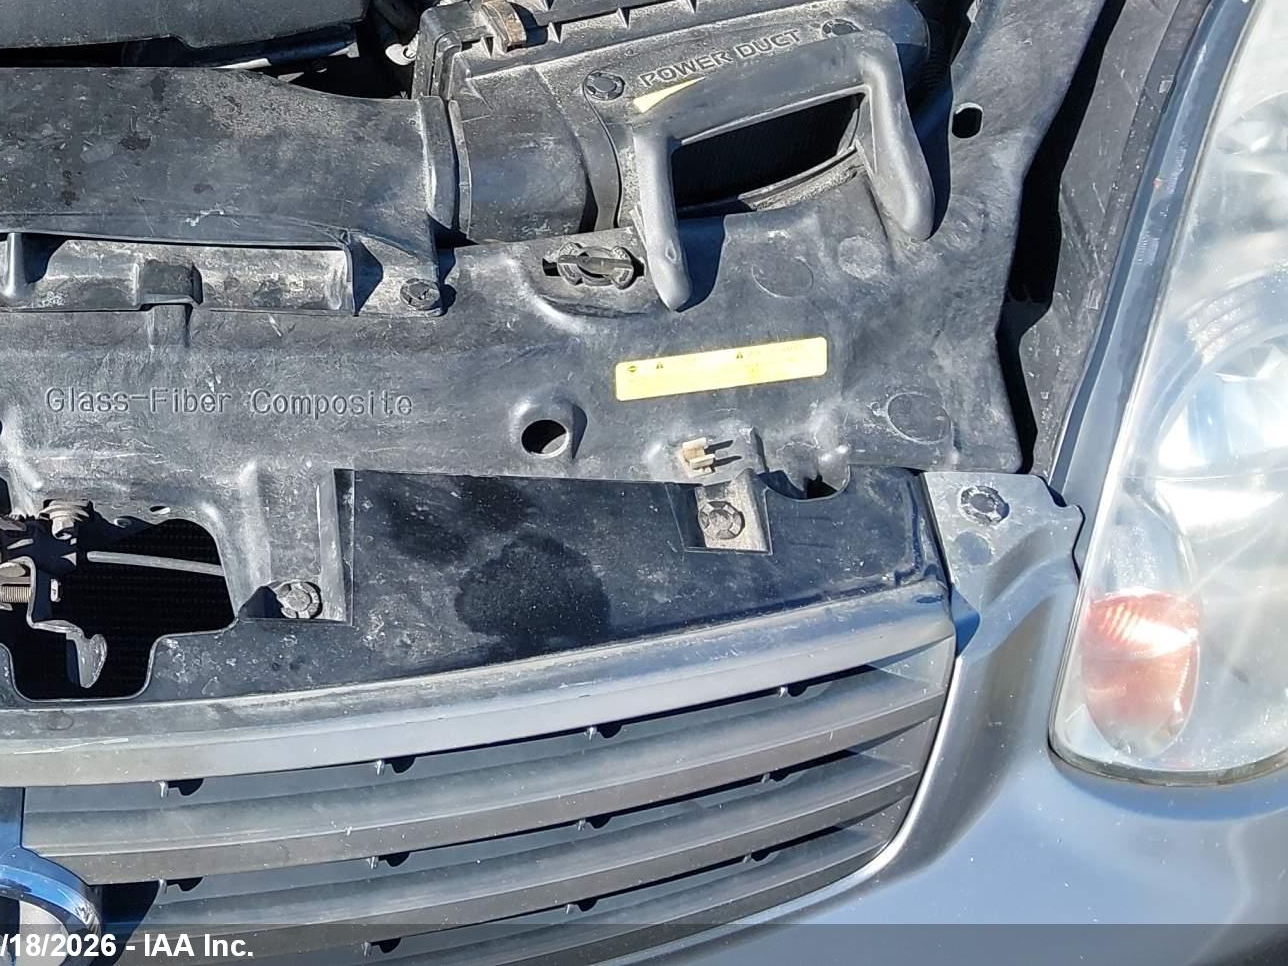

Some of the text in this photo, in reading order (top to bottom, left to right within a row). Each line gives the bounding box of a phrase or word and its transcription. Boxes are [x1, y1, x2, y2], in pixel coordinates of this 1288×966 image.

[639, 29, 801, 87] POWER DUCT
[45, 387, 412, 419] Glass-Fiber Composite
